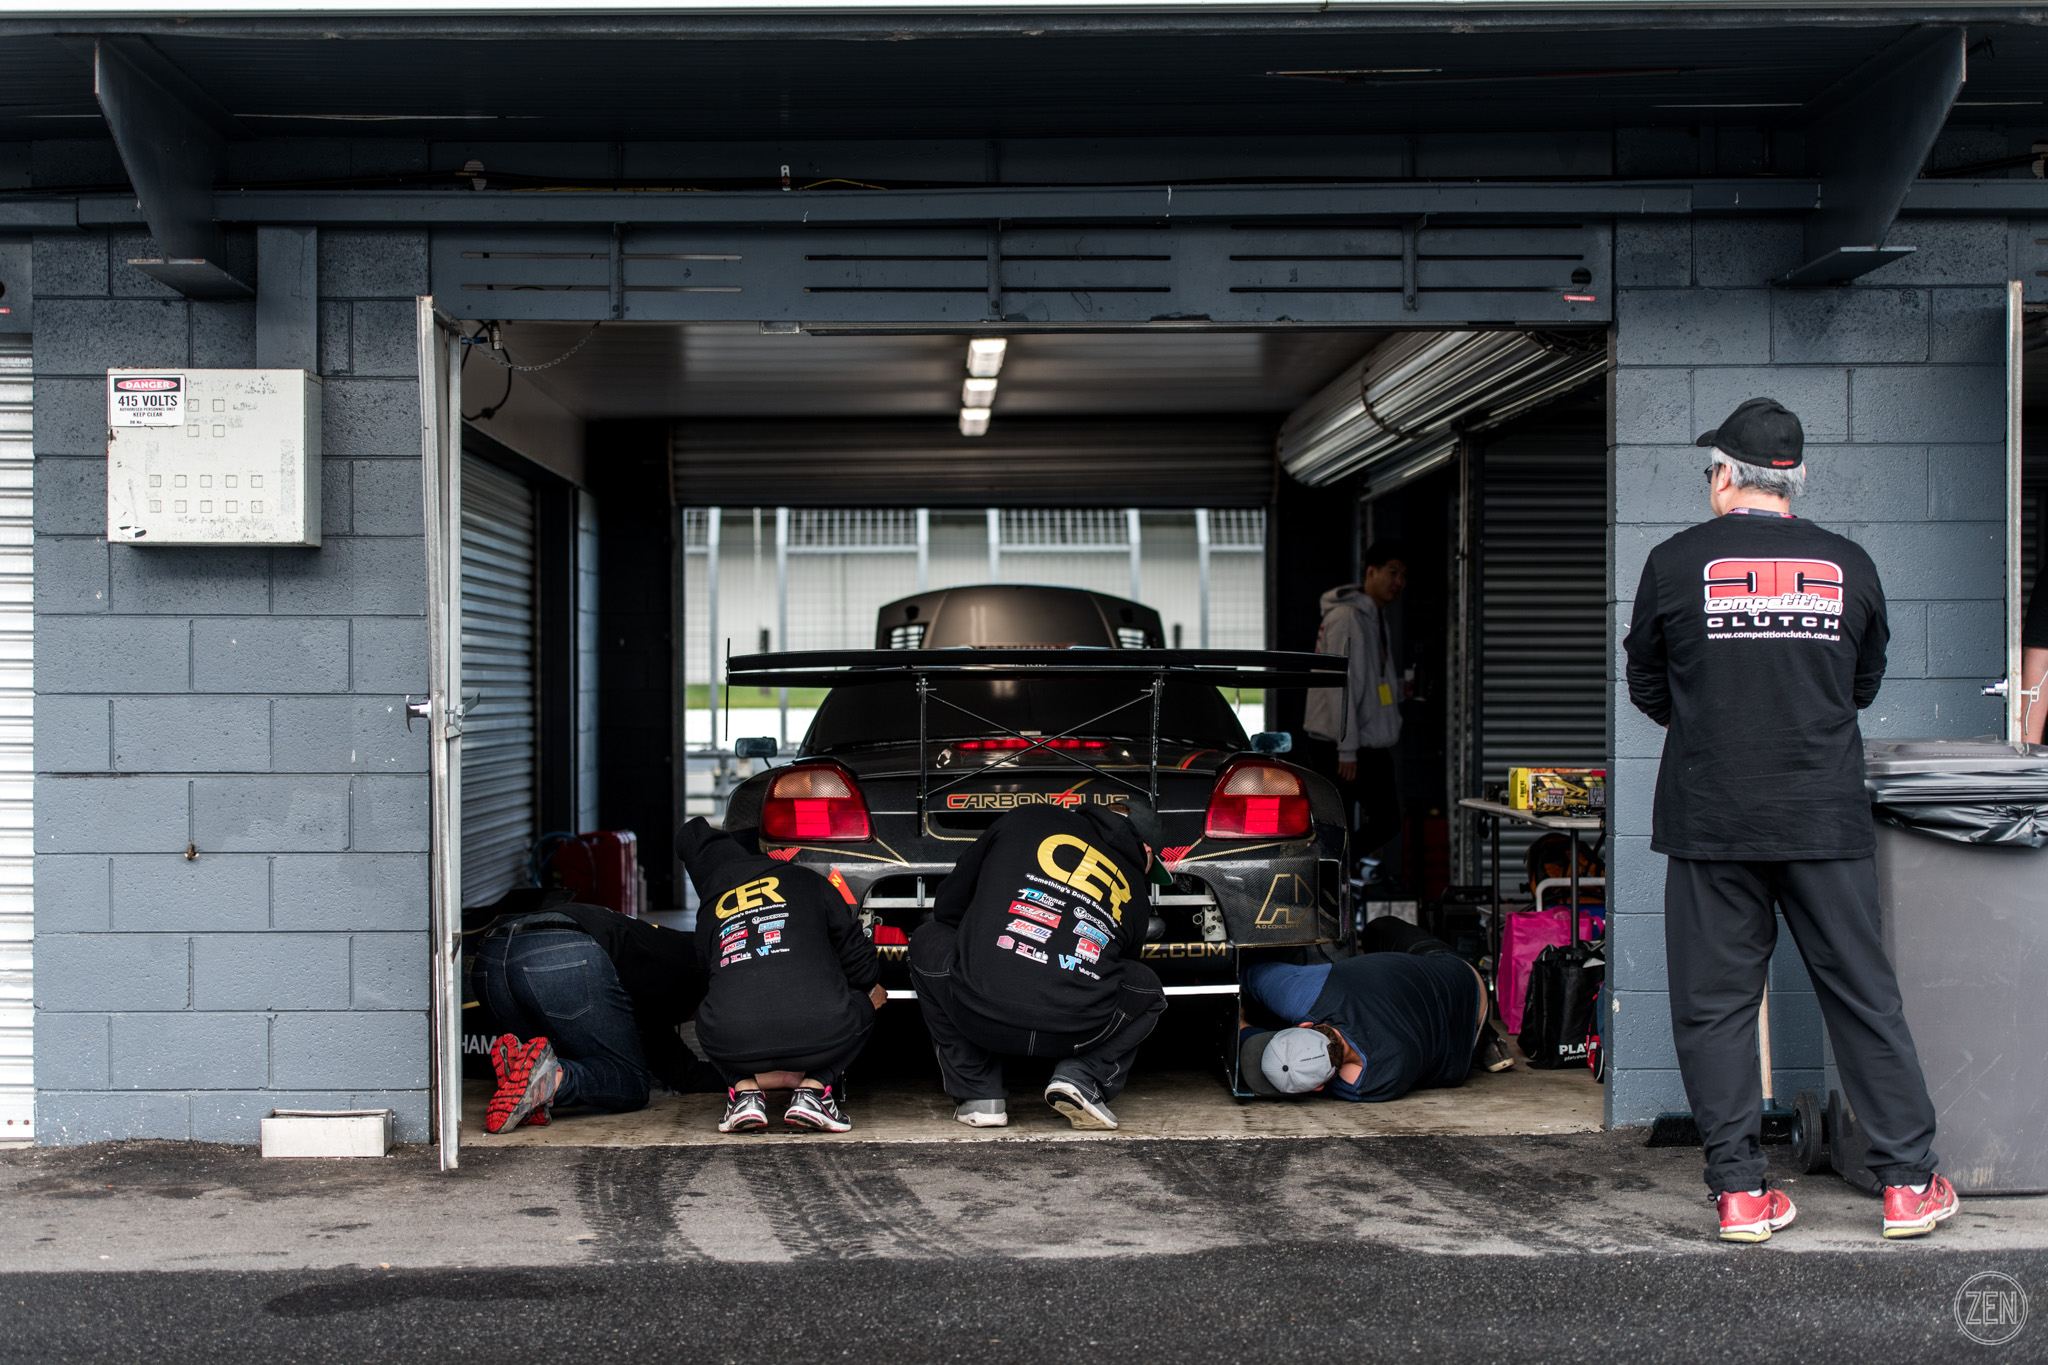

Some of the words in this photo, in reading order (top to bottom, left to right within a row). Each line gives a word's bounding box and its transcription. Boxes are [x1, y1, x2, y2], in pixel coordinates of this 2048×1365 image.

[126, 381, 170, 389] DANGER
[118, 395, 138, 407] 415
[142, 395, 178, 407] VOLTS
[1704, 593, 1843, 616] competition
[1706, 616, 1840, 630] CLUTCH
[1707, 630, 1841, 641] www.competitionclutch.com.au
[1037, 833, 1132, 926] CER
[715, 876, 787, 919] CER
[1039, 897, 1055, 907] Auto
[1043, 892, 1068, 907] Promax
[1071, 890, 1091, 905] Doing
[1011, 920, 1051, 937] AMSOIL
